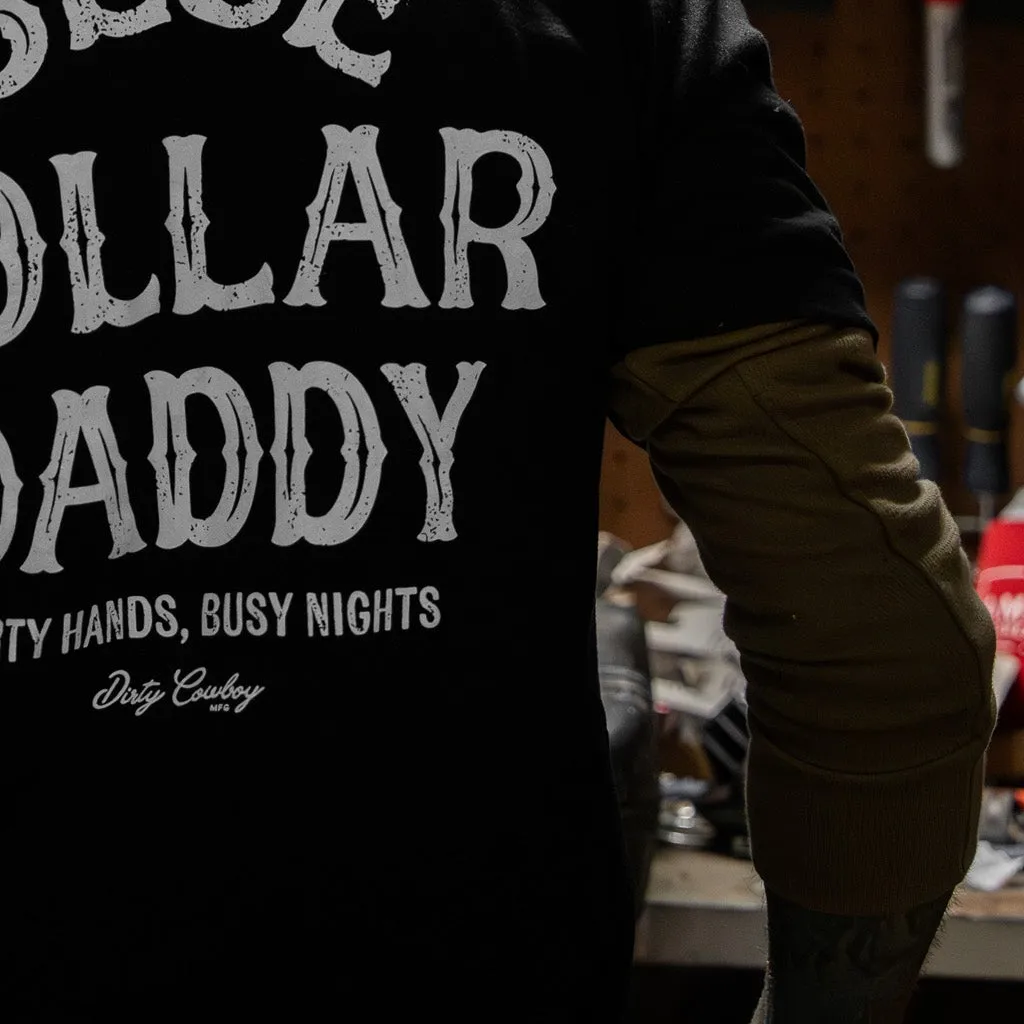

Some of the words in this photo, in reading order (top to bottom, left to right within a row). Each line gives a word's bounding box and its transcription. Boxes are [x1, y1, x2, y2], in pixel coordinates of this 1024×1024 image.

[61, 594, 190, 654] HANDS,
[201, 592, 294, 637] BUSY
[306, 586, 441, 637] NIGHTS
[92, 669, 166, 717] Dirty
[171, 666, 266, 714] Cowboy
[209, 703, 230, 712] MFG
